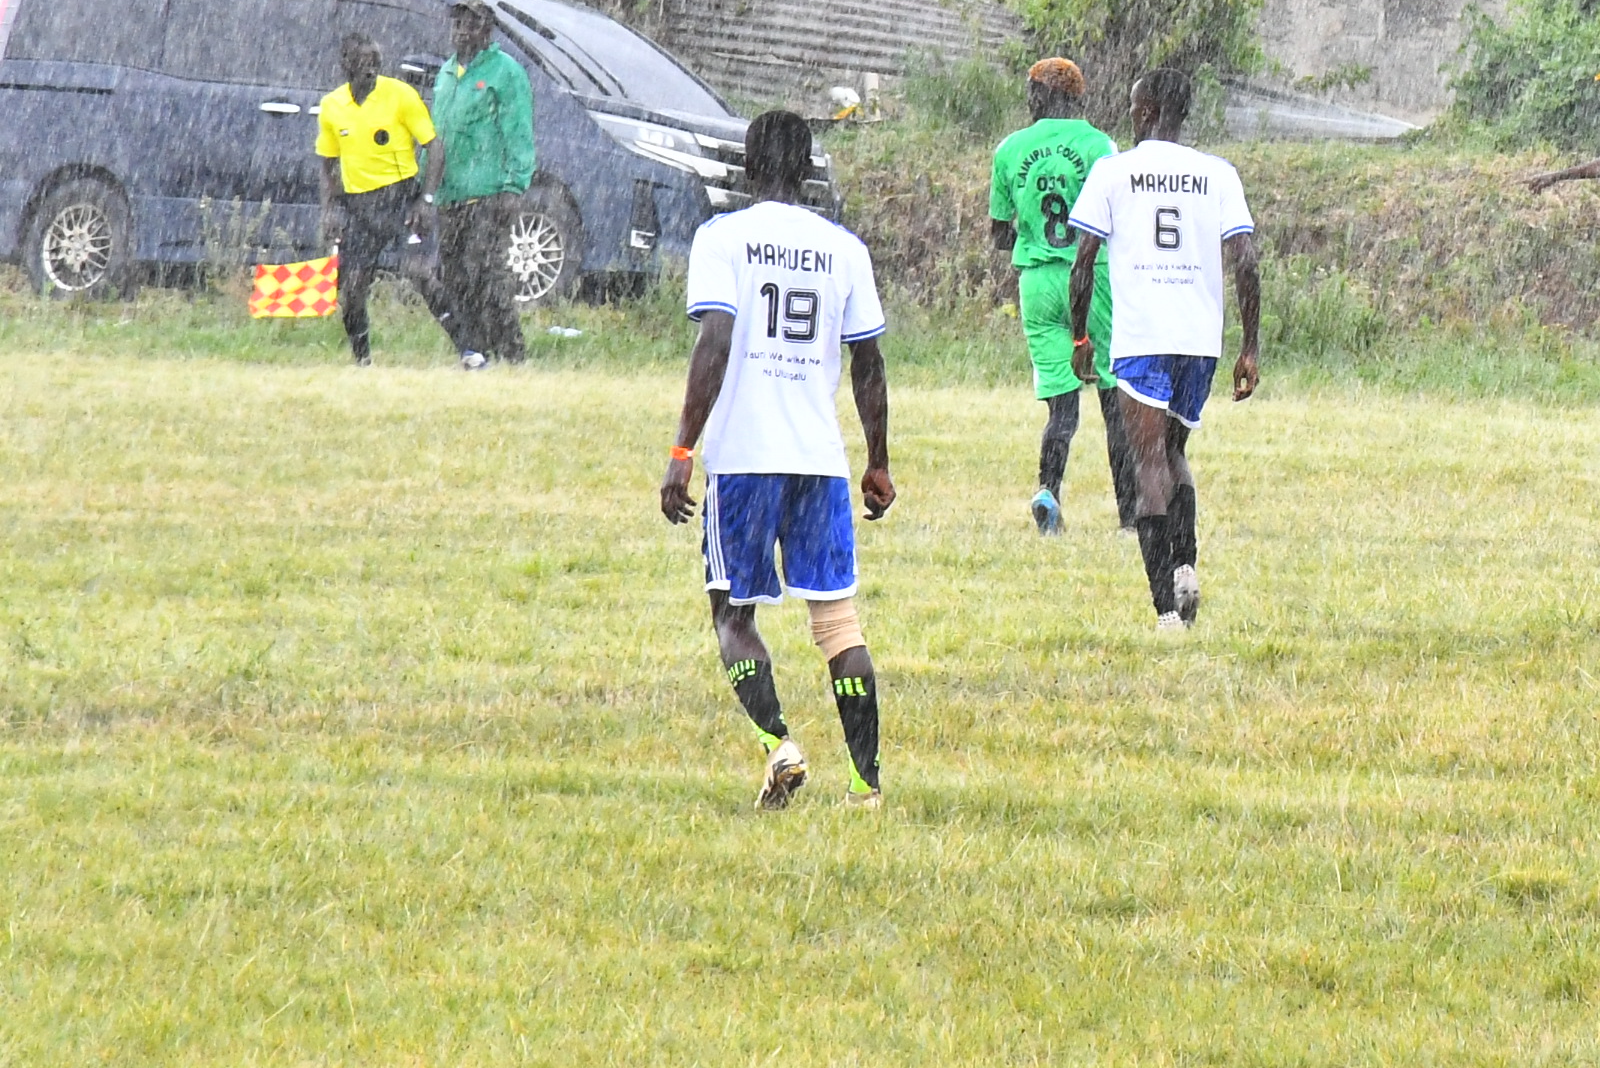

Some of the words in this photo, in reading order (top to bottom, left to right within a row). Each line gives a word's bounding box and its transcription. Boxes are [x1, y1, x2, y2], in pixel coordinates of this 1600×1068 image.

[1017, 146, 1053, 189] LAIKIPIA
[1036, 173, 1067, 192] 031
[1130, 172, 1208, 196] MAKUENI
[1041, 192, 1077, 249] 8
[1153, 205, 1183, 252] 6
[746, 242, 833, 275] MAKUENI
[760, 282, 822, 344] 19
